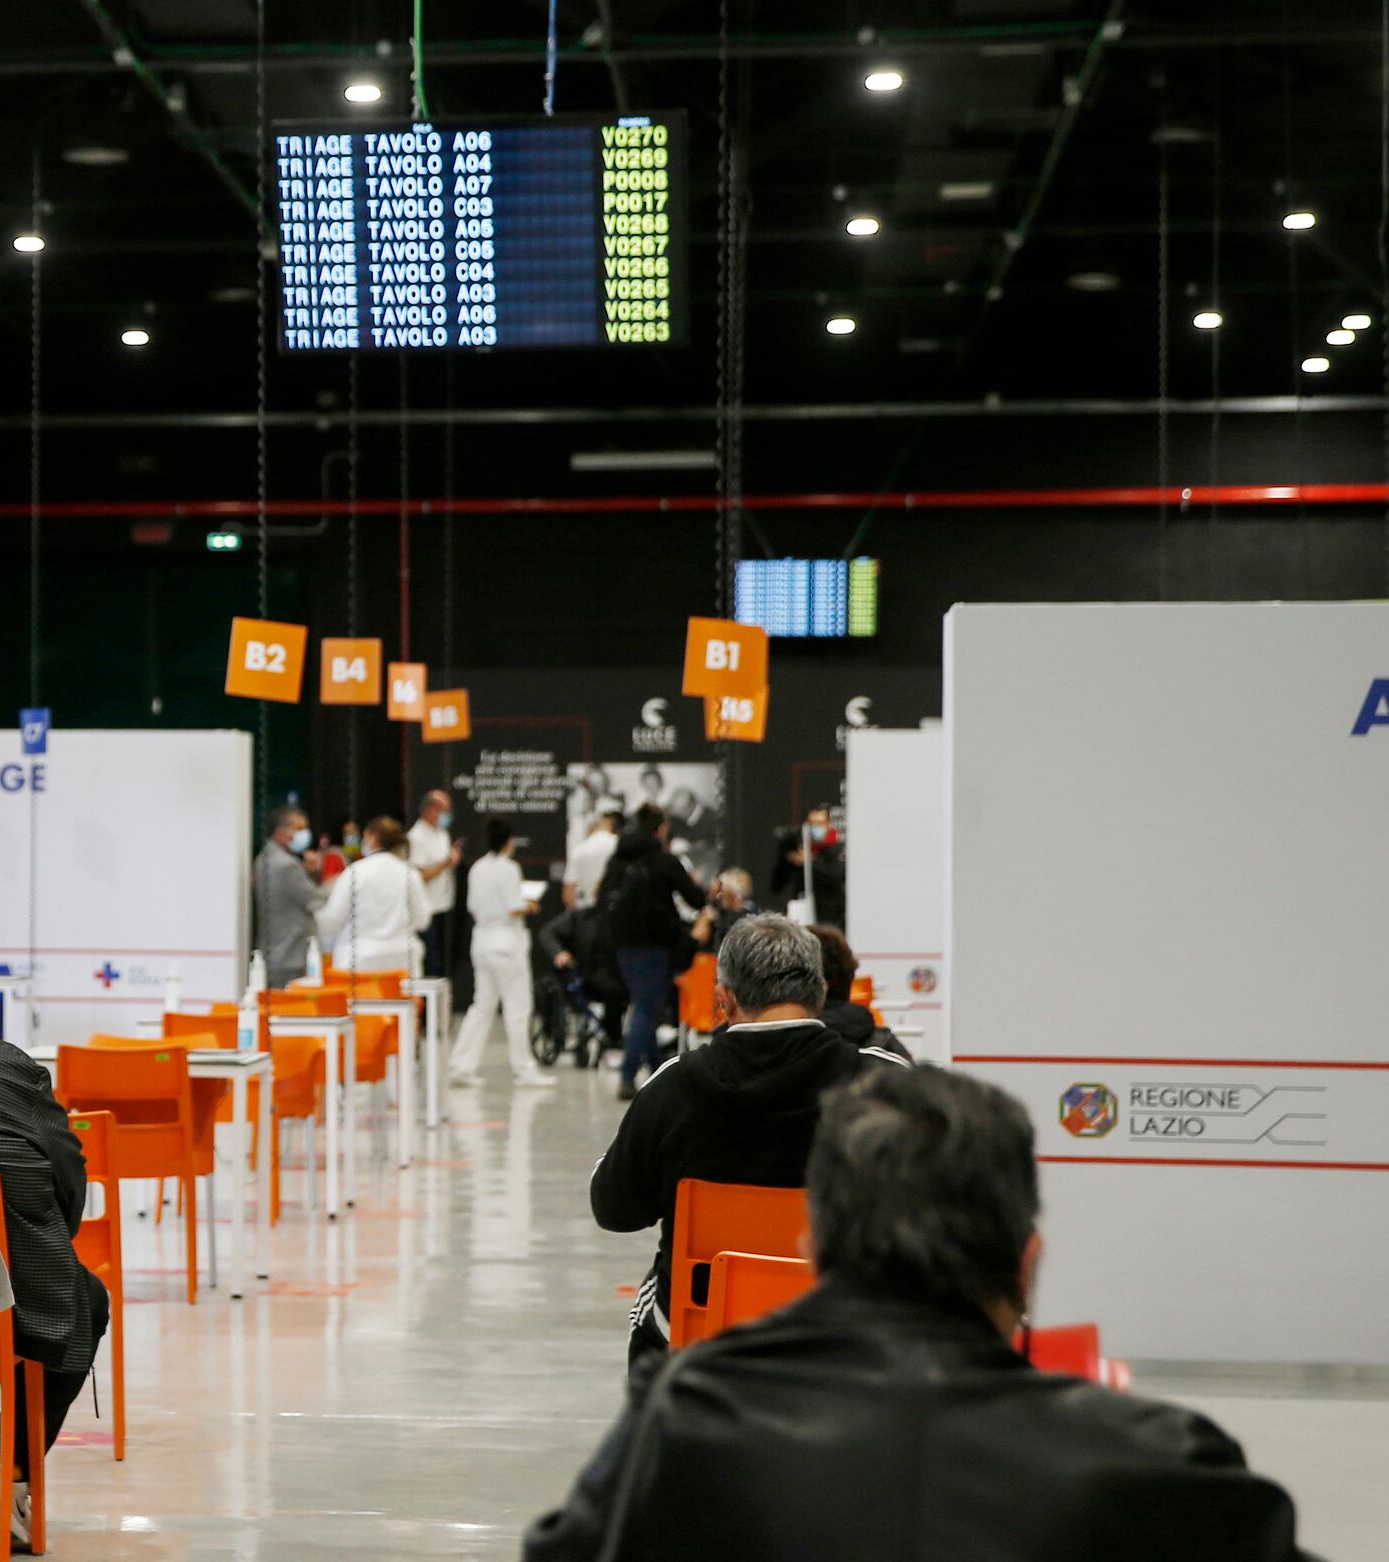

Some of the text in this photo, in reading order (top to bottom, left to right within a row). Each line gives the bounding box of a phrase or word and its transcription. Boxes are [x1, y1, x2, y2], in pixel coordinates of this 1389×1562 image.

[277, 134, 353, 157] TRIAGE
[364, 132, 442, 154] TAVOLO
[601, 125, 667, 148] V0270
[278, 156, 354, 178] TRIAGE
[365, 154, 443, 176] TAVOLO
[453, 153, 493, 174] A04
[279, 178, 354, 200] TRIAGE
[366, 175, 443, 197] TAVOLO
[454, 174, 494, 195] A07
[279, 190, 668, 221] TRIAGE TAVOLO C03 P0017
[280, 220, 356, 242] TRIAGE
[367, 218, 445, 240] TAVOLO
[281, 242, 357, 263] TRIAGE
[368, 240, 445, 262] TAVOLO
[603, 234, 669, 256] V0267
[282, 264, 357, 285] TRIAGE
[369, 261, 446, 283] TAVOLO
[456, 261, 496, 282] C04
[283, 285, 358, 306] TRIAGE
[369, 283, 447, 304] TAVOLO
[457, 282, 497, 303] A03
[284, 306, 359, 327] TRIAGE
[370, 304, 447, 326] TAVOLO
[605, 299, 670, 321] V0264
[285, 321, 670, 348] TRIAGE TAVOLO A03 V0263
[244, 640, 287, 673] B2
[705, 639, 740, 671] B1
[331, 656, 367, 683] B4
[1129, 1087, 1241, 1109] REGIONE
[1129, 1116, 1206, 1136] LAZIO
